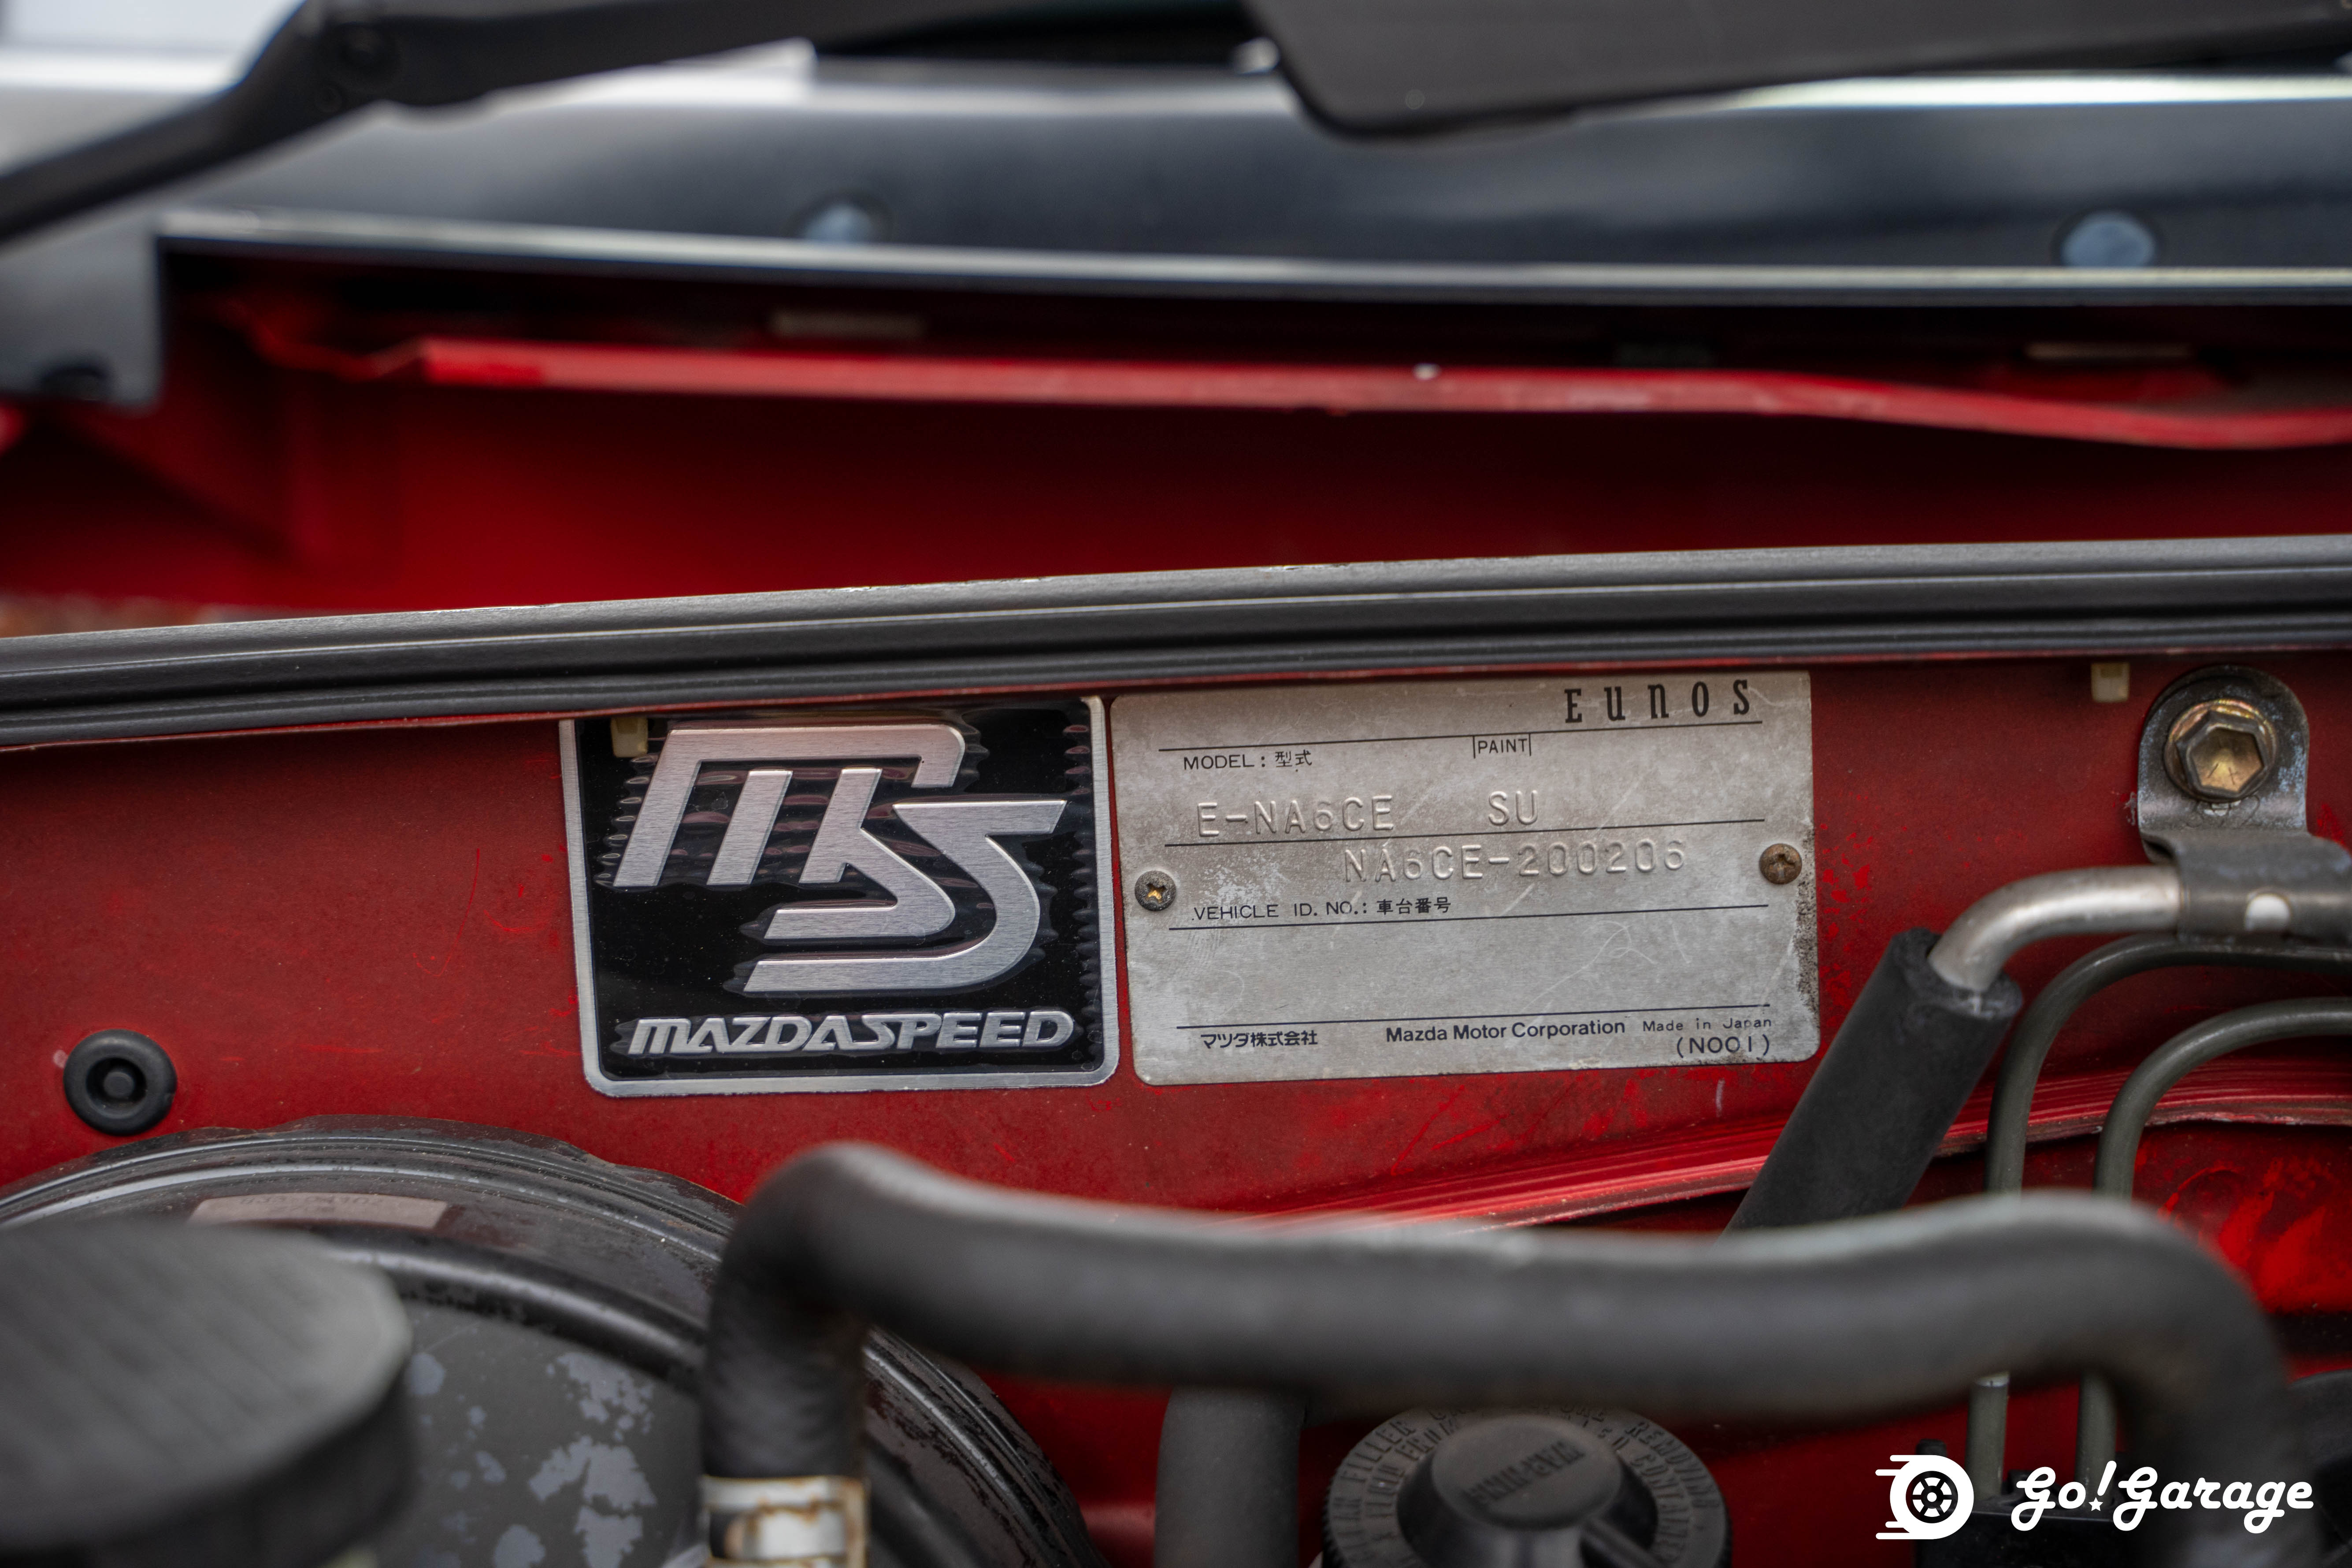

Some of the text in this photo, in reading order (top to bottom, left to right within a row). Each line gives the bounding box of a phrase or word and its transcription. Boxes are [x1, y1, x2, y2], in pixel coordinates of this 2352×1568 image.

[1477, 738, 1527, 754] PAINT
[1274, 749, 1313, 768] 型式
[1197, 795, 1394, 837] E-NA6CE
[1488, 790, 1539, 826] SU
[1344, 838, 1686, 882] NA6CE-200206
[1194, 904, 1279, 921] VEHICLE
[1294, 903, 1318, 917] ID.
[1376, 897, 1451, 916] 車台番号
[627, 1011, 1076, 1055] MAZDASPEED
[1386, 1020, 1625, 1042] Mazda Motor Corporation
[1642, 1016, 1772, 1032] Made in Japan
[1200, 1030, 1318, 1049] マツダ株式会社
